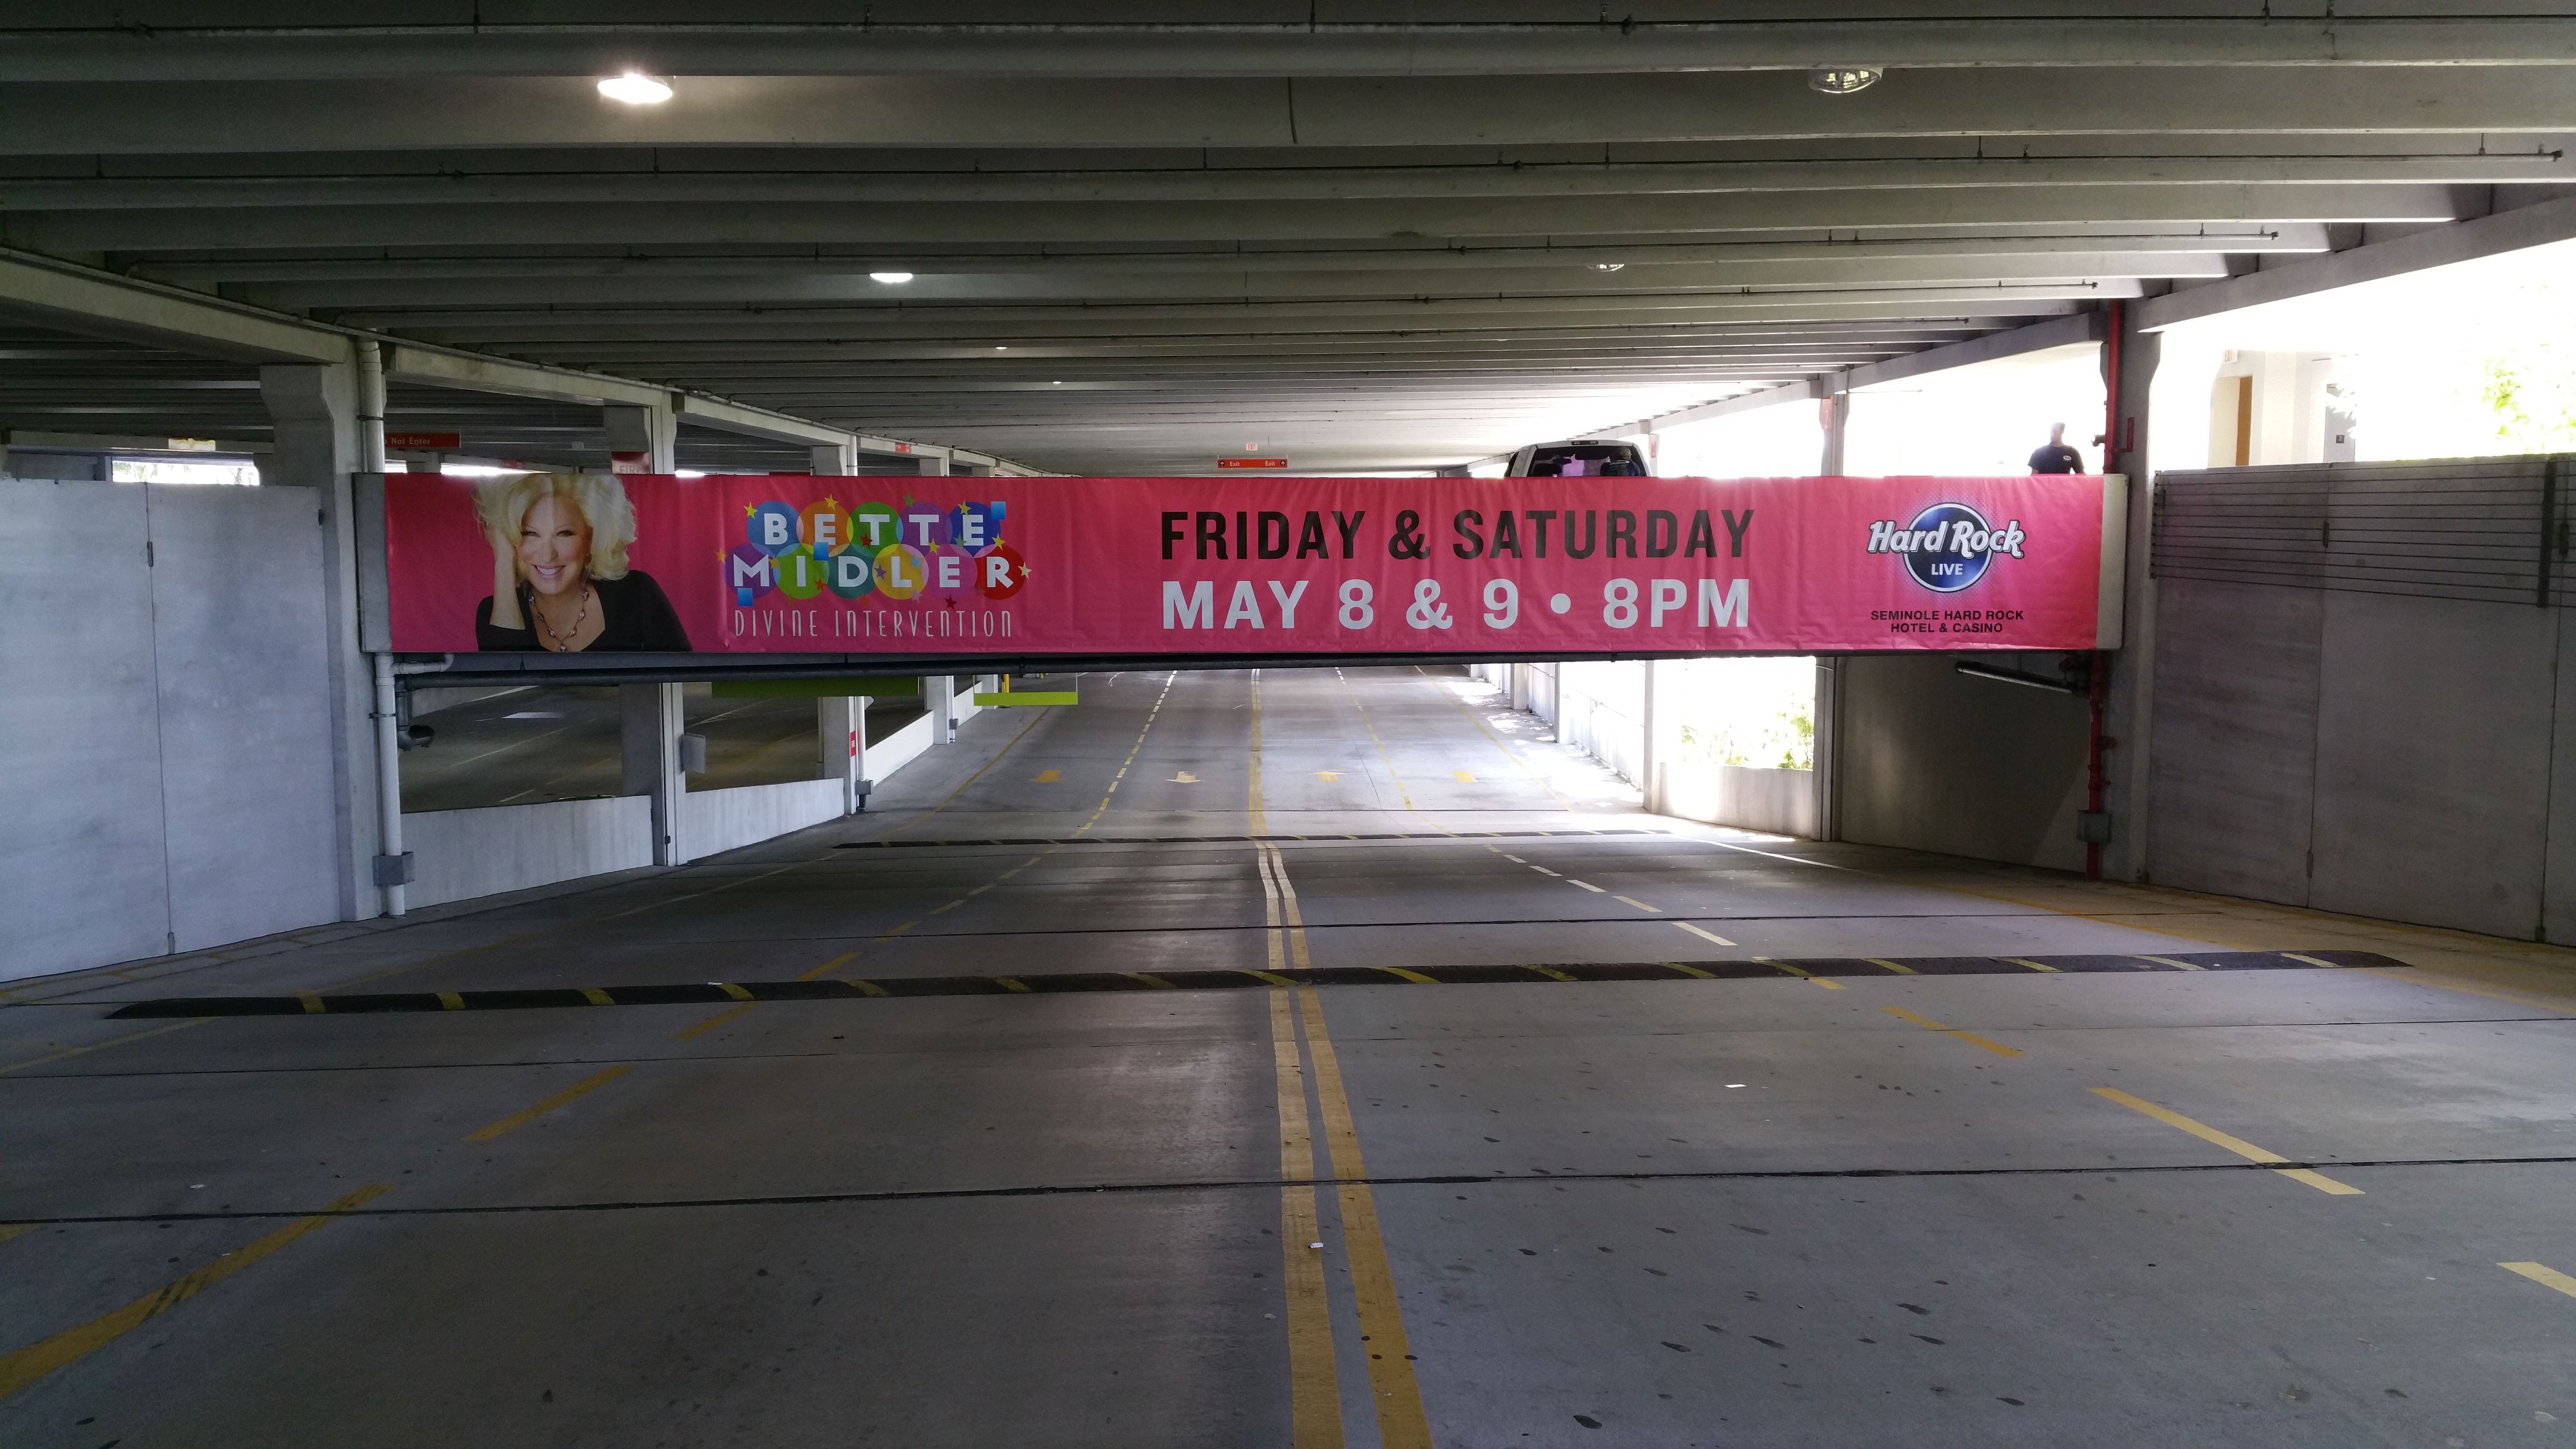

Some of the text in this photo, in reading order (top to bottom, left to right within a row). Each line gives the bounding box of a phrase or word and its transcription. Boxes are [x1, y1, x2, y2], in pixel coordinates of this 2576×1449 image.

[763, 513, 984, 547] BETTE
[1161, 509, 1755, 561] FRIDAY & SATURDAY
[1867, 519, 2026, 559] Hard Rock
[733, 553, 1014, 588] MIDLER
[1931, 563, 1964, 576] LIVE
[1162, 580, 1309, 629] MAY
[1338, 579, 1374, 630] 8
[1405, 578, 1453, 630] &
[1483, 578, 1519, 629] 9
[1603, 578, 1750, 629] 8PM
[1870, 610, 2025, 621] SEMINOLE HARD ROCK
[735, 610, 1012, 637] DIVINE INTERVENTION
[1890, 622, 2003, 633] HOTEL & CASINO
